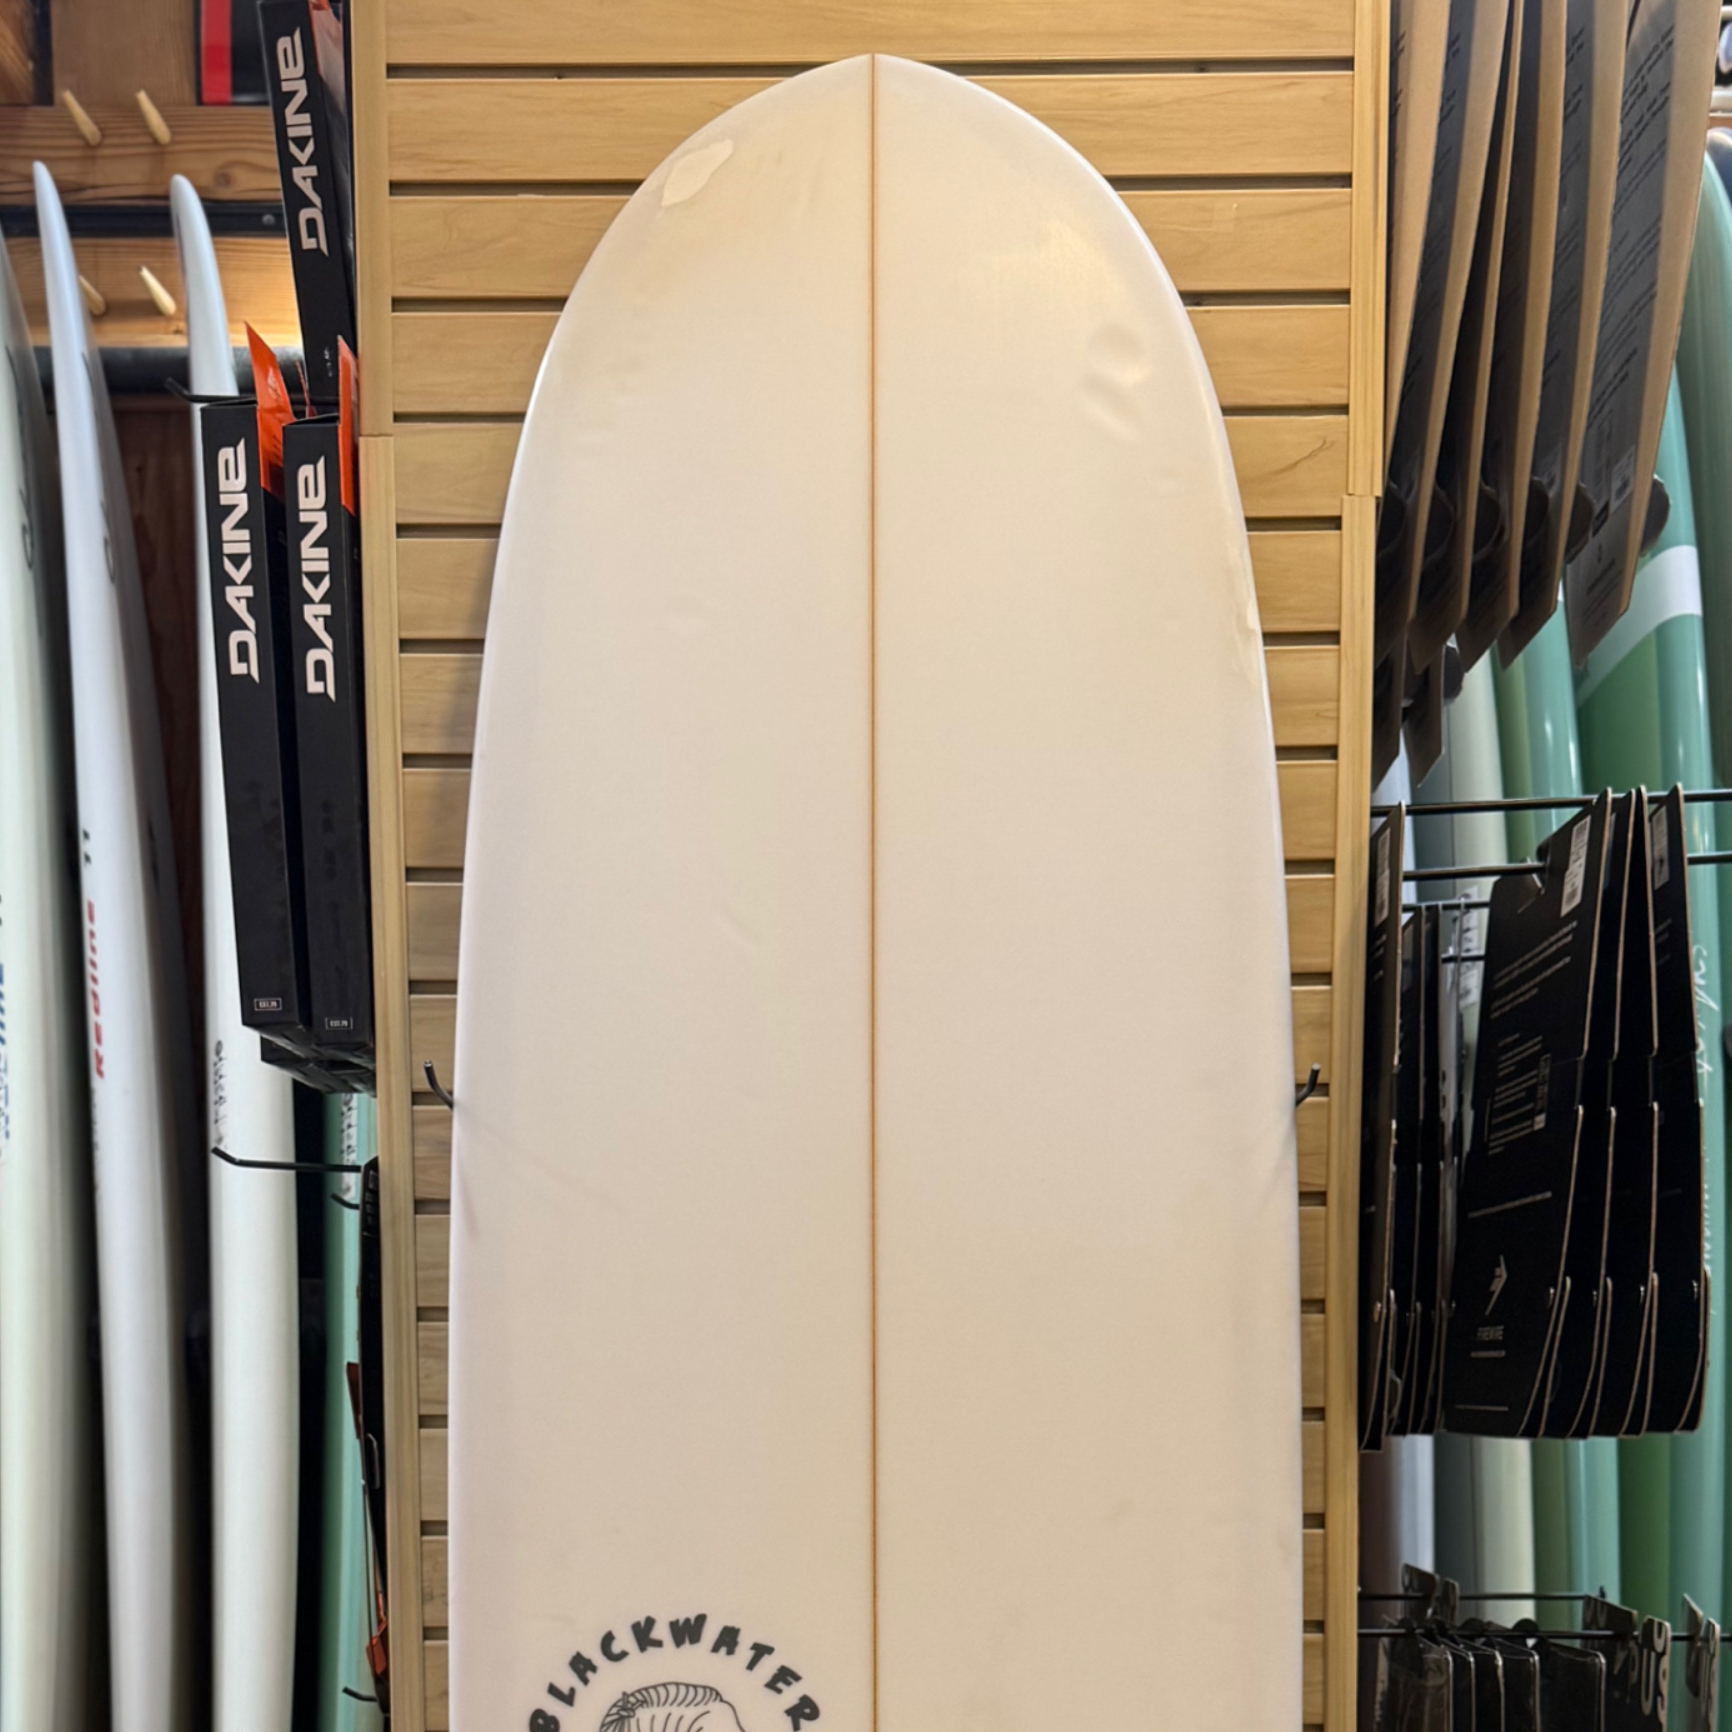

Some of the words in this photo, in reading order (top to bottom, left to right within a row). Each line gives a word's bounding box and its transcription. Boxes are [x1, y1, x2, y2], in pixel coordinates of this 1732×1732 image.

[276, 27, 329, 256] DAKINE
[217, 438, 260, 683] DAKINE
[297, 455, 336, 702] DAKINE
